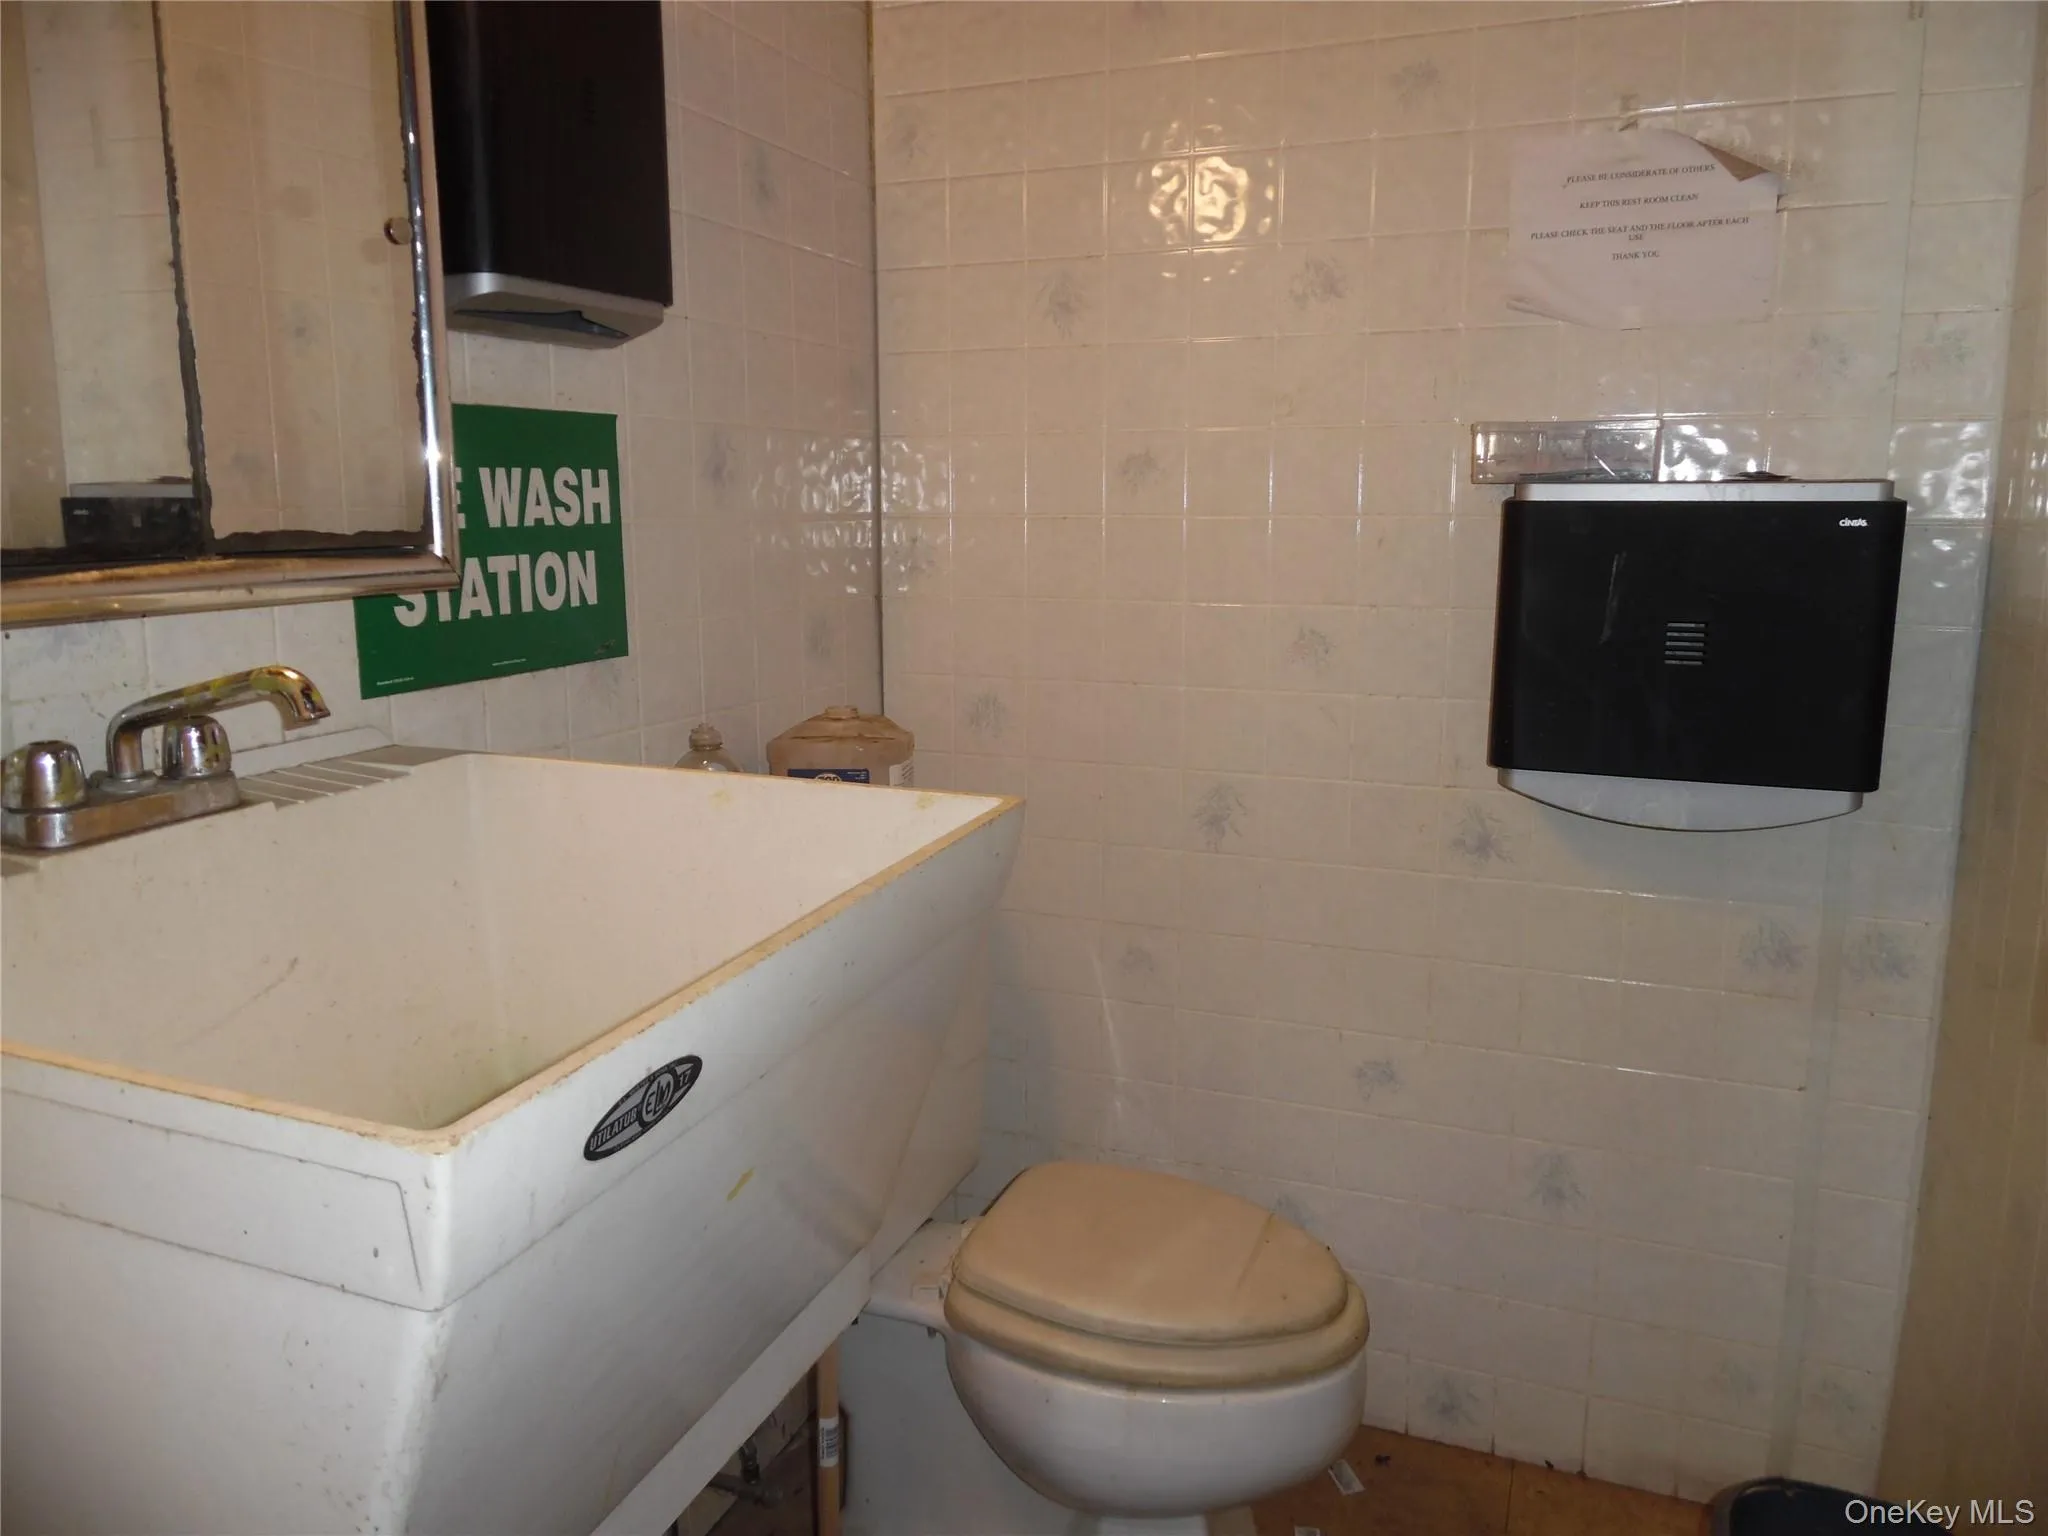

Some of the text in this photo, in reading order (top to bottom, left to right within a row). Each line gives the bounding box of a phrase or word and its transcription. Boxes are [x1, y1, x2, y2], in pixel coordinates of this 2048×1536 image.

[1566, 174, 1596, 184] PLEASE
[1610, 167, 1668, 181] CONSIDERATE
[1669, 167, 1680, 176] OF
[1681, 163, 1716, 174] OTHERS
[1579, 192, 1700, 209] KEEP THIS REST ROOM CLEAN
[1531, 215, 1750, 241] PLEASE CHECK THE SEAT AND THE FLOOR AFTER EACH
[1628, 232, 1644, 242] USE
[1611, 250, 1640, 261] THANK
[478, 466, 612, 529] WASH
[589, 1106, 639, 1152] UTILATUB
